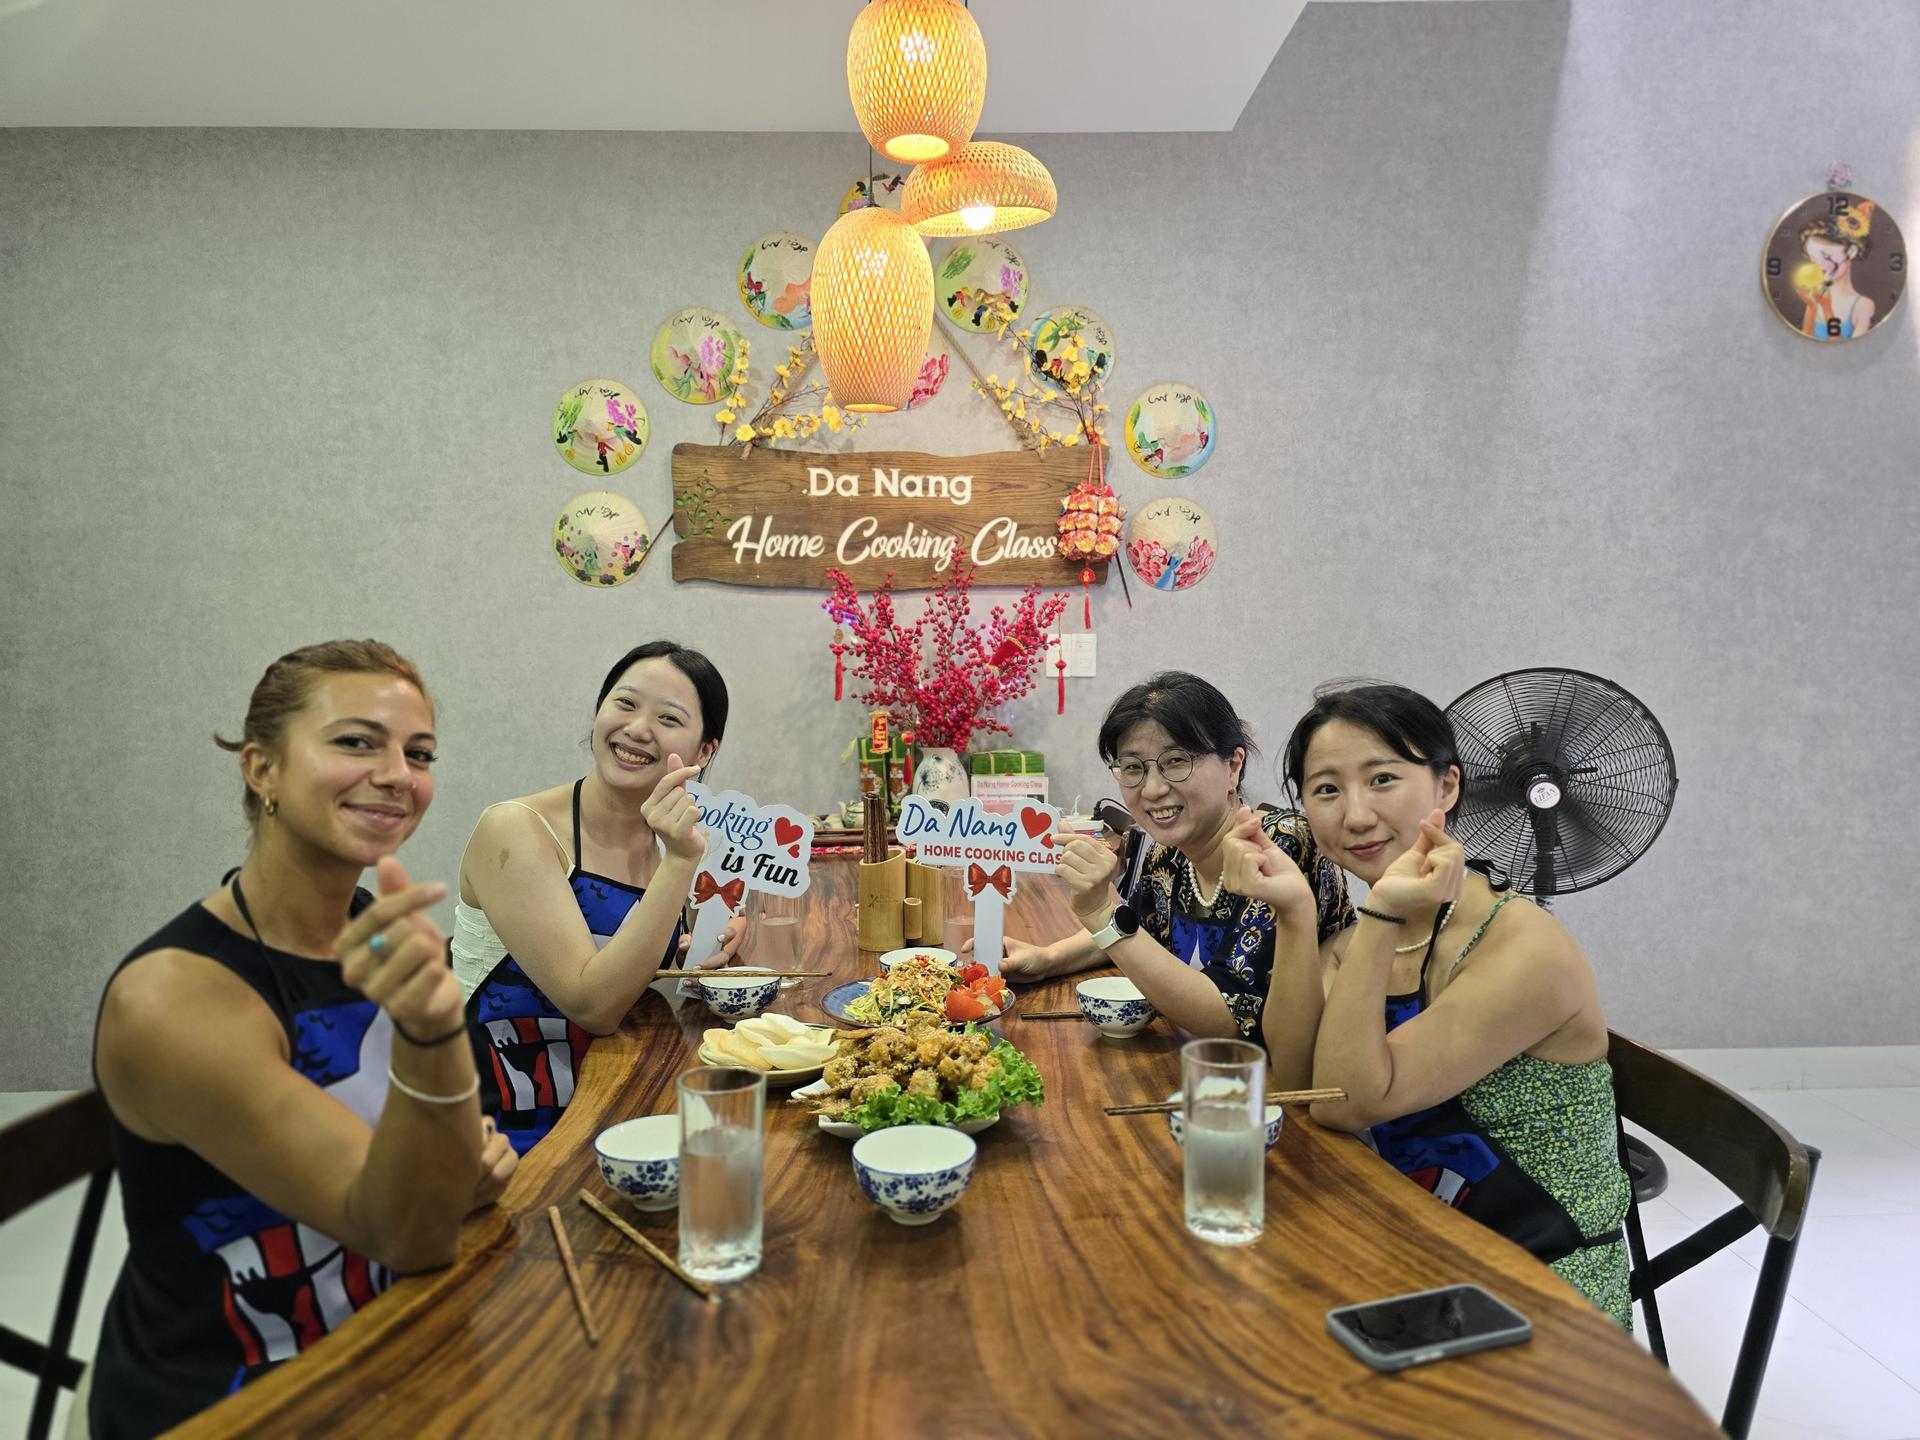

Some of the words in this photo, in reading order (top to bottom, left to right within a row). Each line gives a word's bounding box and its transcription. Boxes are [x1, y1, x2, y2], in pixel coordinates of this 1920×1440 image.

[1827, 197, 1849, 216] 12
[1768, 257, 1782, 276] 9
[1889, 253, 1903, 272] 3
[1827, 318, 1841, 337] 6
[808, 467, 860, 497] Da
[872, 467, 974, 506] Nang
[727, 515, 826, 564] Home
[837, 516, 957, 572] Cooking
[971, 516, 1058, 567] Class
[688, 793, 773, 851] ooking
[903, 803, 939, 836] Da
[949, 806, 1018, 847] Nang
[721, 847, 744, 873] is
[752, 853, 800, 888] Fun
[924, 844, 961, 859] HOME
[965, 847, 1025, 863] COOKING
[1028, 851, 1063, 865] CLAS
